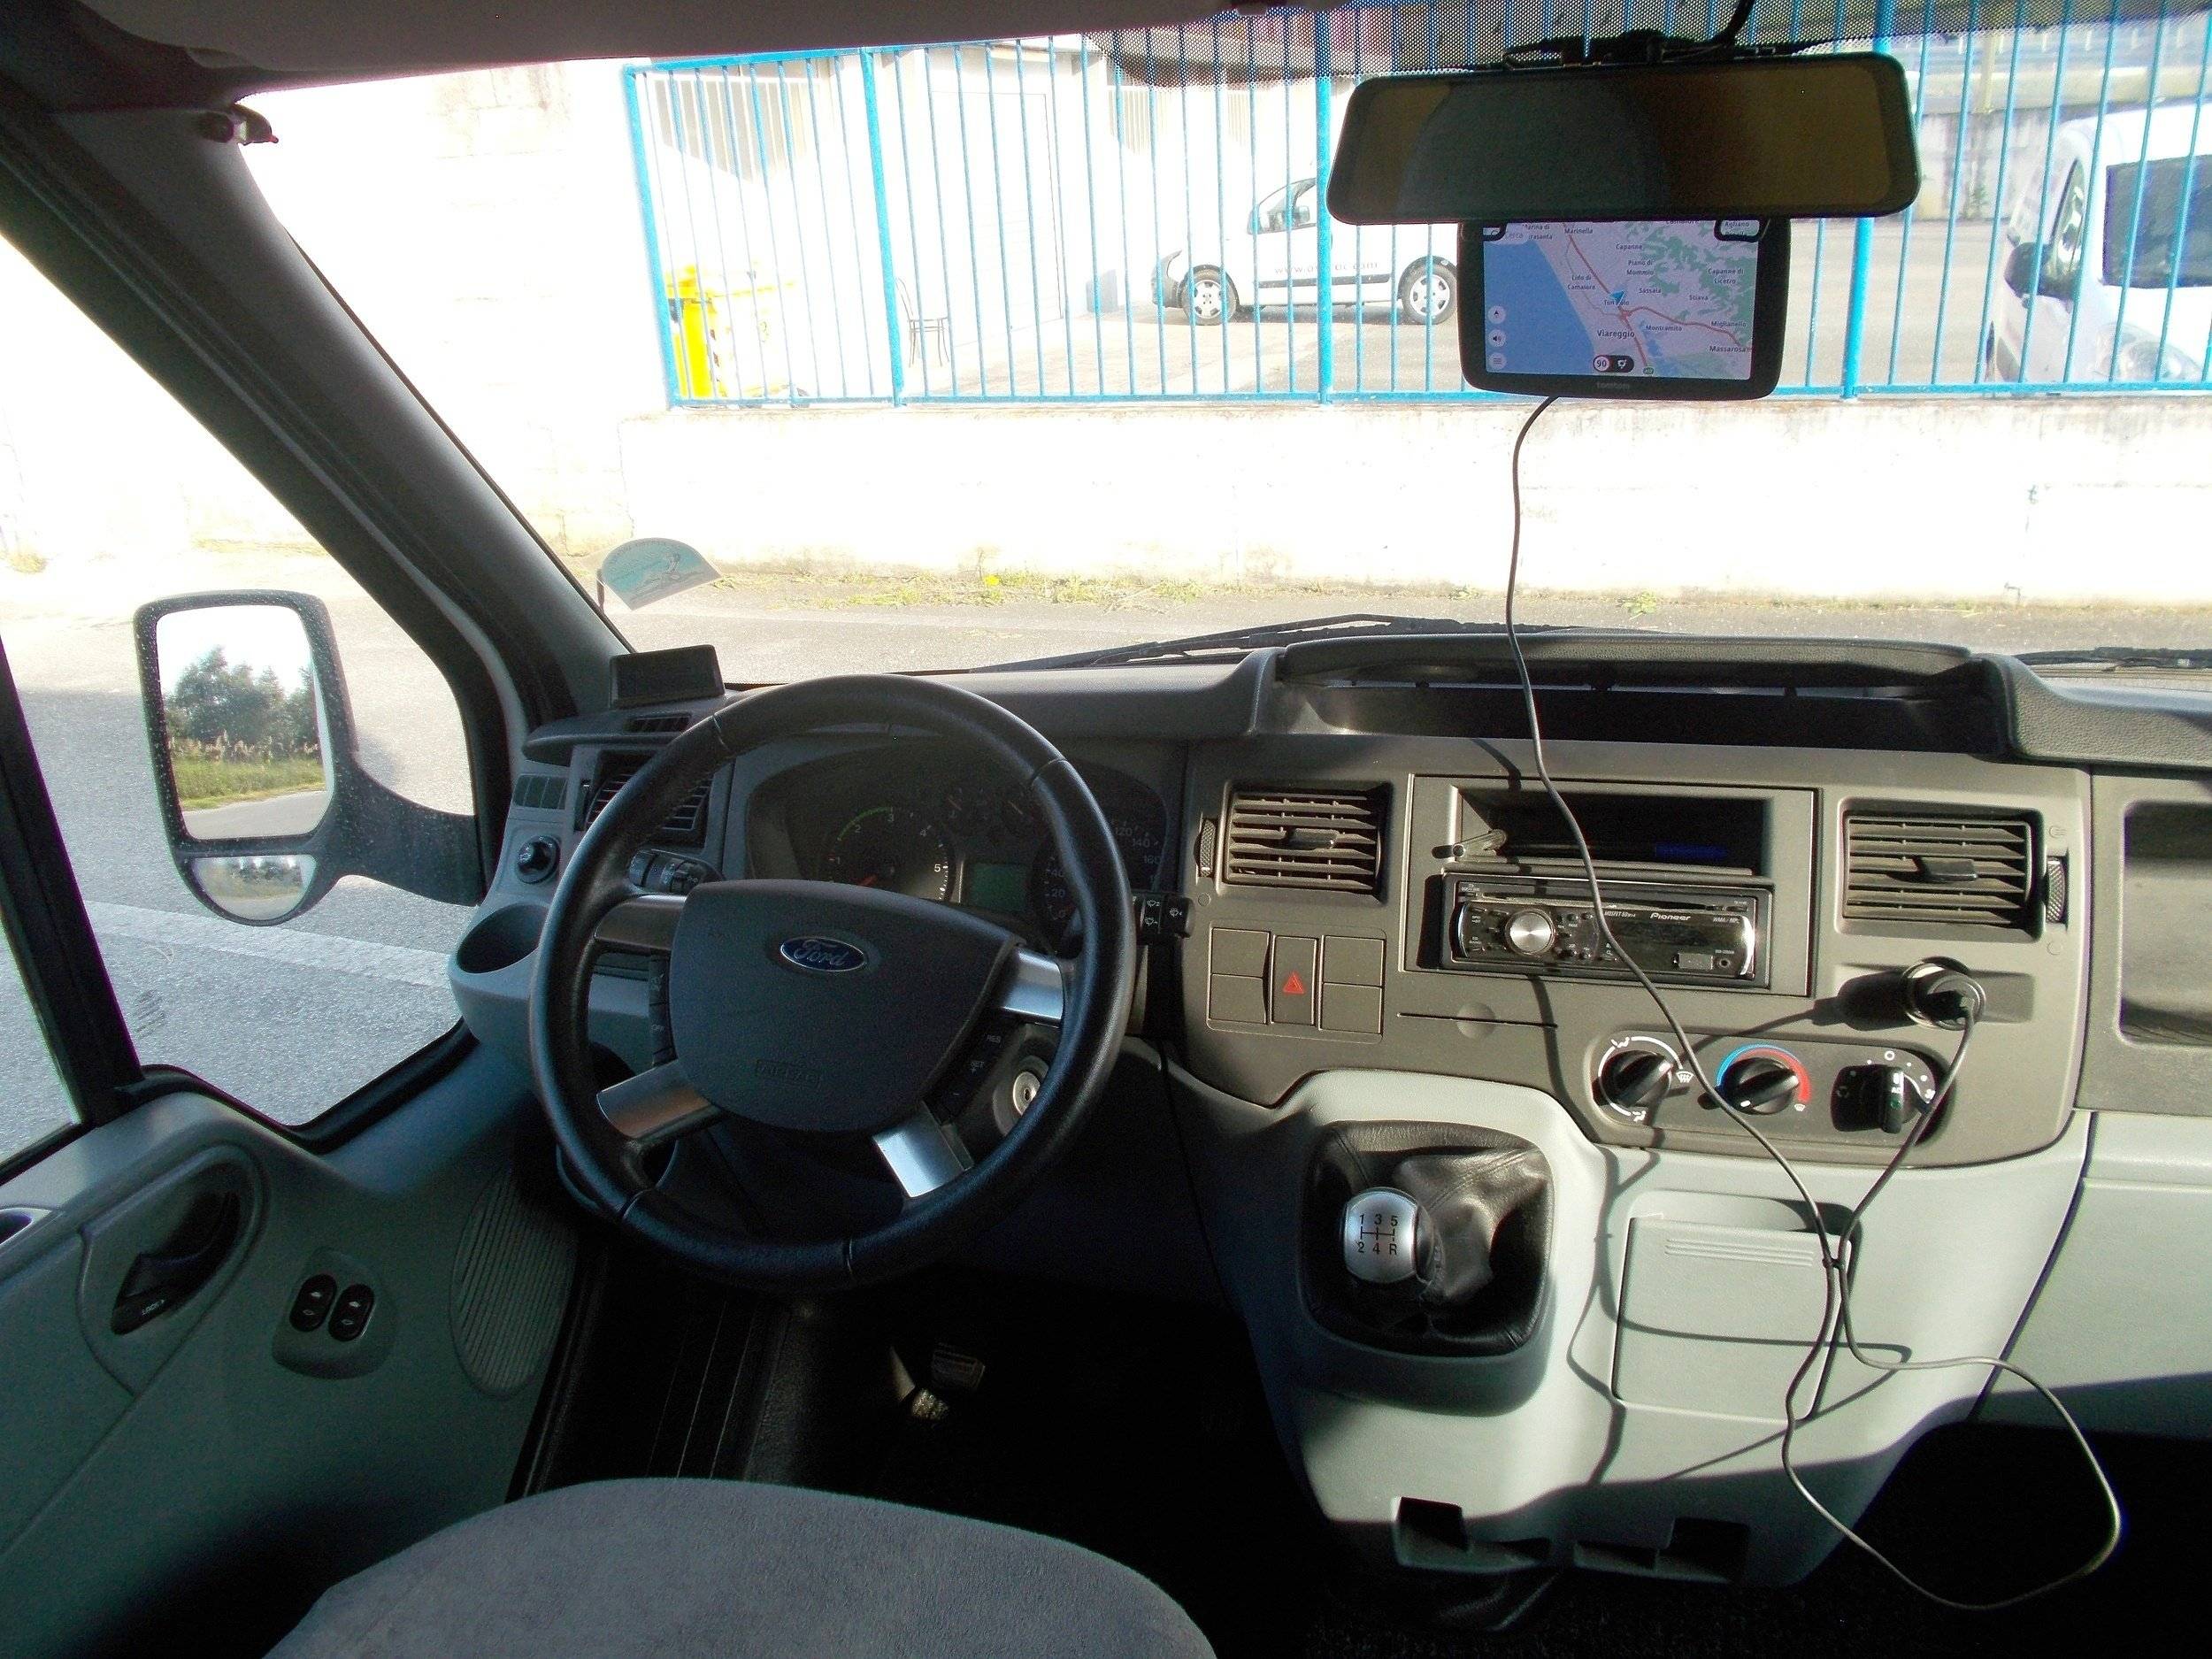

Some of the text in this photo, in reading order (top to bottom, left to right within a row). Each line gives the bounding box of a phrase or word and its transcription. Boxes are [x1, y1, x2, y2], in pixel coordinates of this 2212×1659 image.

[1596, 329, 1635, 340] Viareggio
[933, 862, 941, 872] 5
[1650, 912, 1691, 921] Pioneer
[793, 938, 849, 967] Ford
[1359, 1213, 1398, 1227] 1 3 5
[1357, 1240, 1397, 1256] 2 4 R
